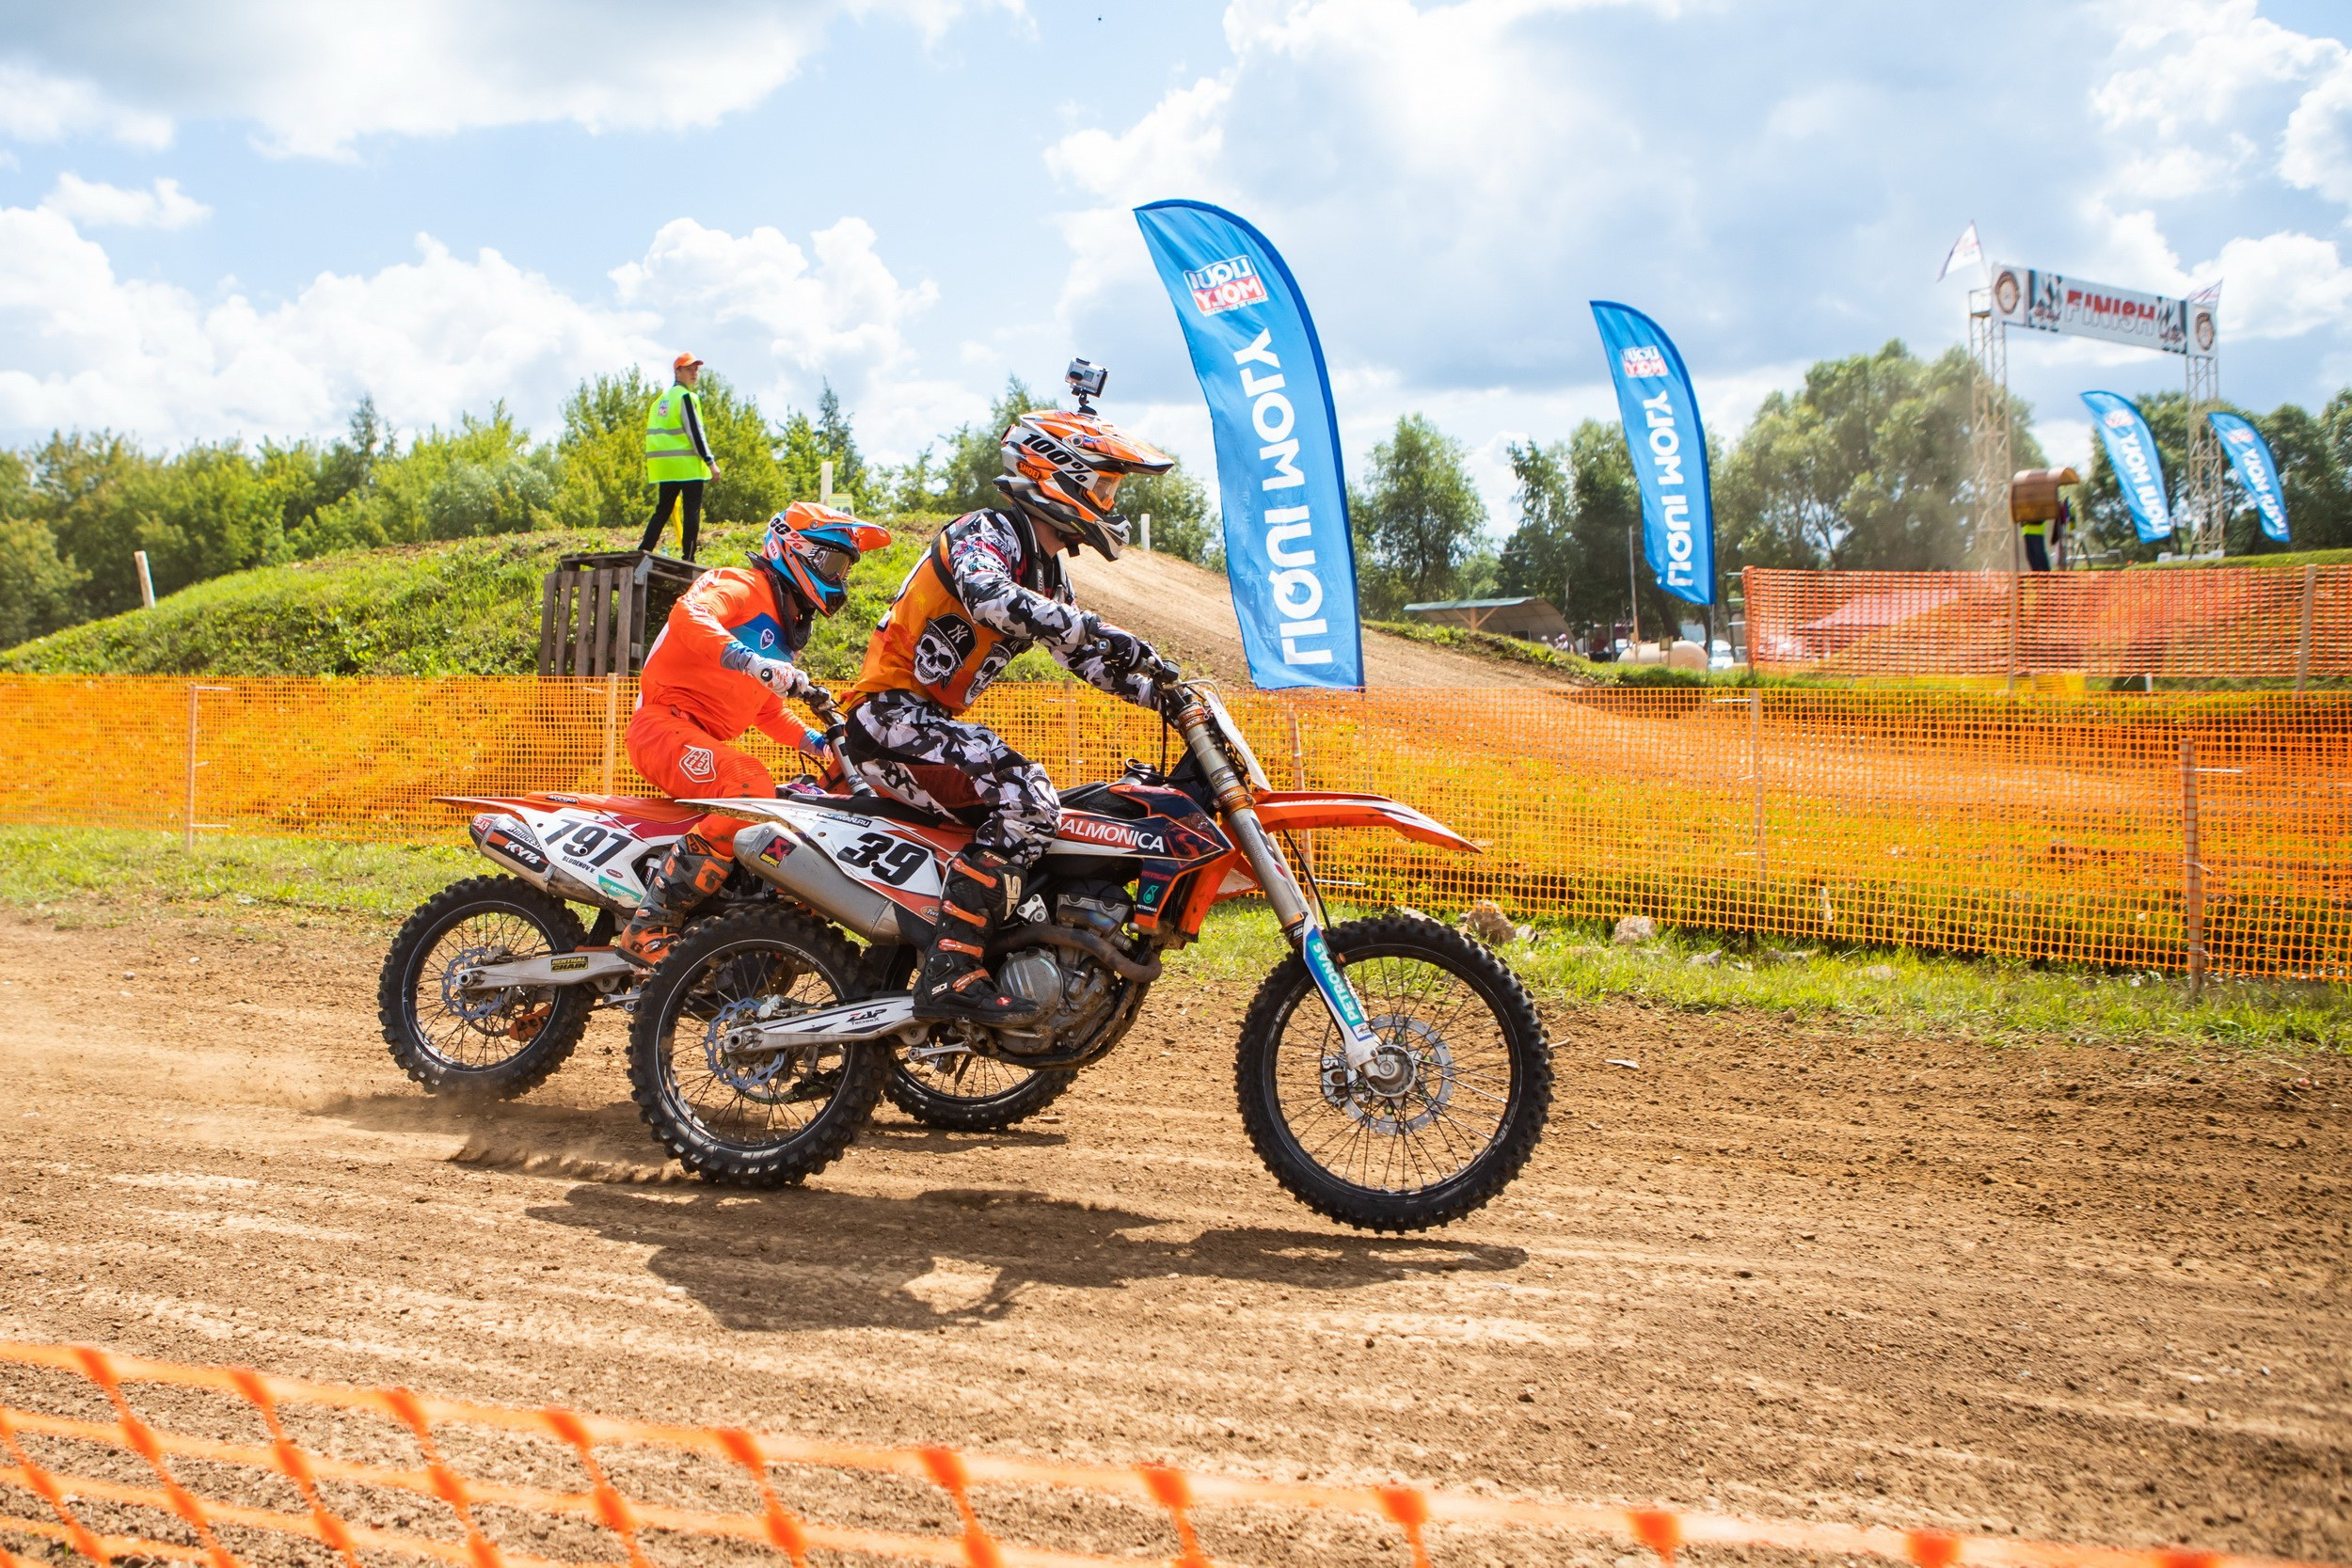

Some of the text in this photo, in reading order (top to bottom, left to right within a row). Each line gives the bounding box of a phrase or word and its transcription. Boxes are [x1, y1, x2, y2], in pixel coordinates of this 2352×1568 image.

[2064, 289, 2156, 337] FINISH
[1023, 433, 1092, 483] 100%
[1019, 462, 1041, 480] SHOEI
[504, 841, 541, 863] KYB
[545, 818, 634, 867] 797
[563, 855, 590, 871] BLUDENOV
[836, 832, 929, 886] 39
[551, 957, 587, 965] RENTHAL
[551, 962, 587, 972] CHAIN
[931, 983, 947, 995] SIDI
[1312, 942, 1359, 1022] PETRONAS
